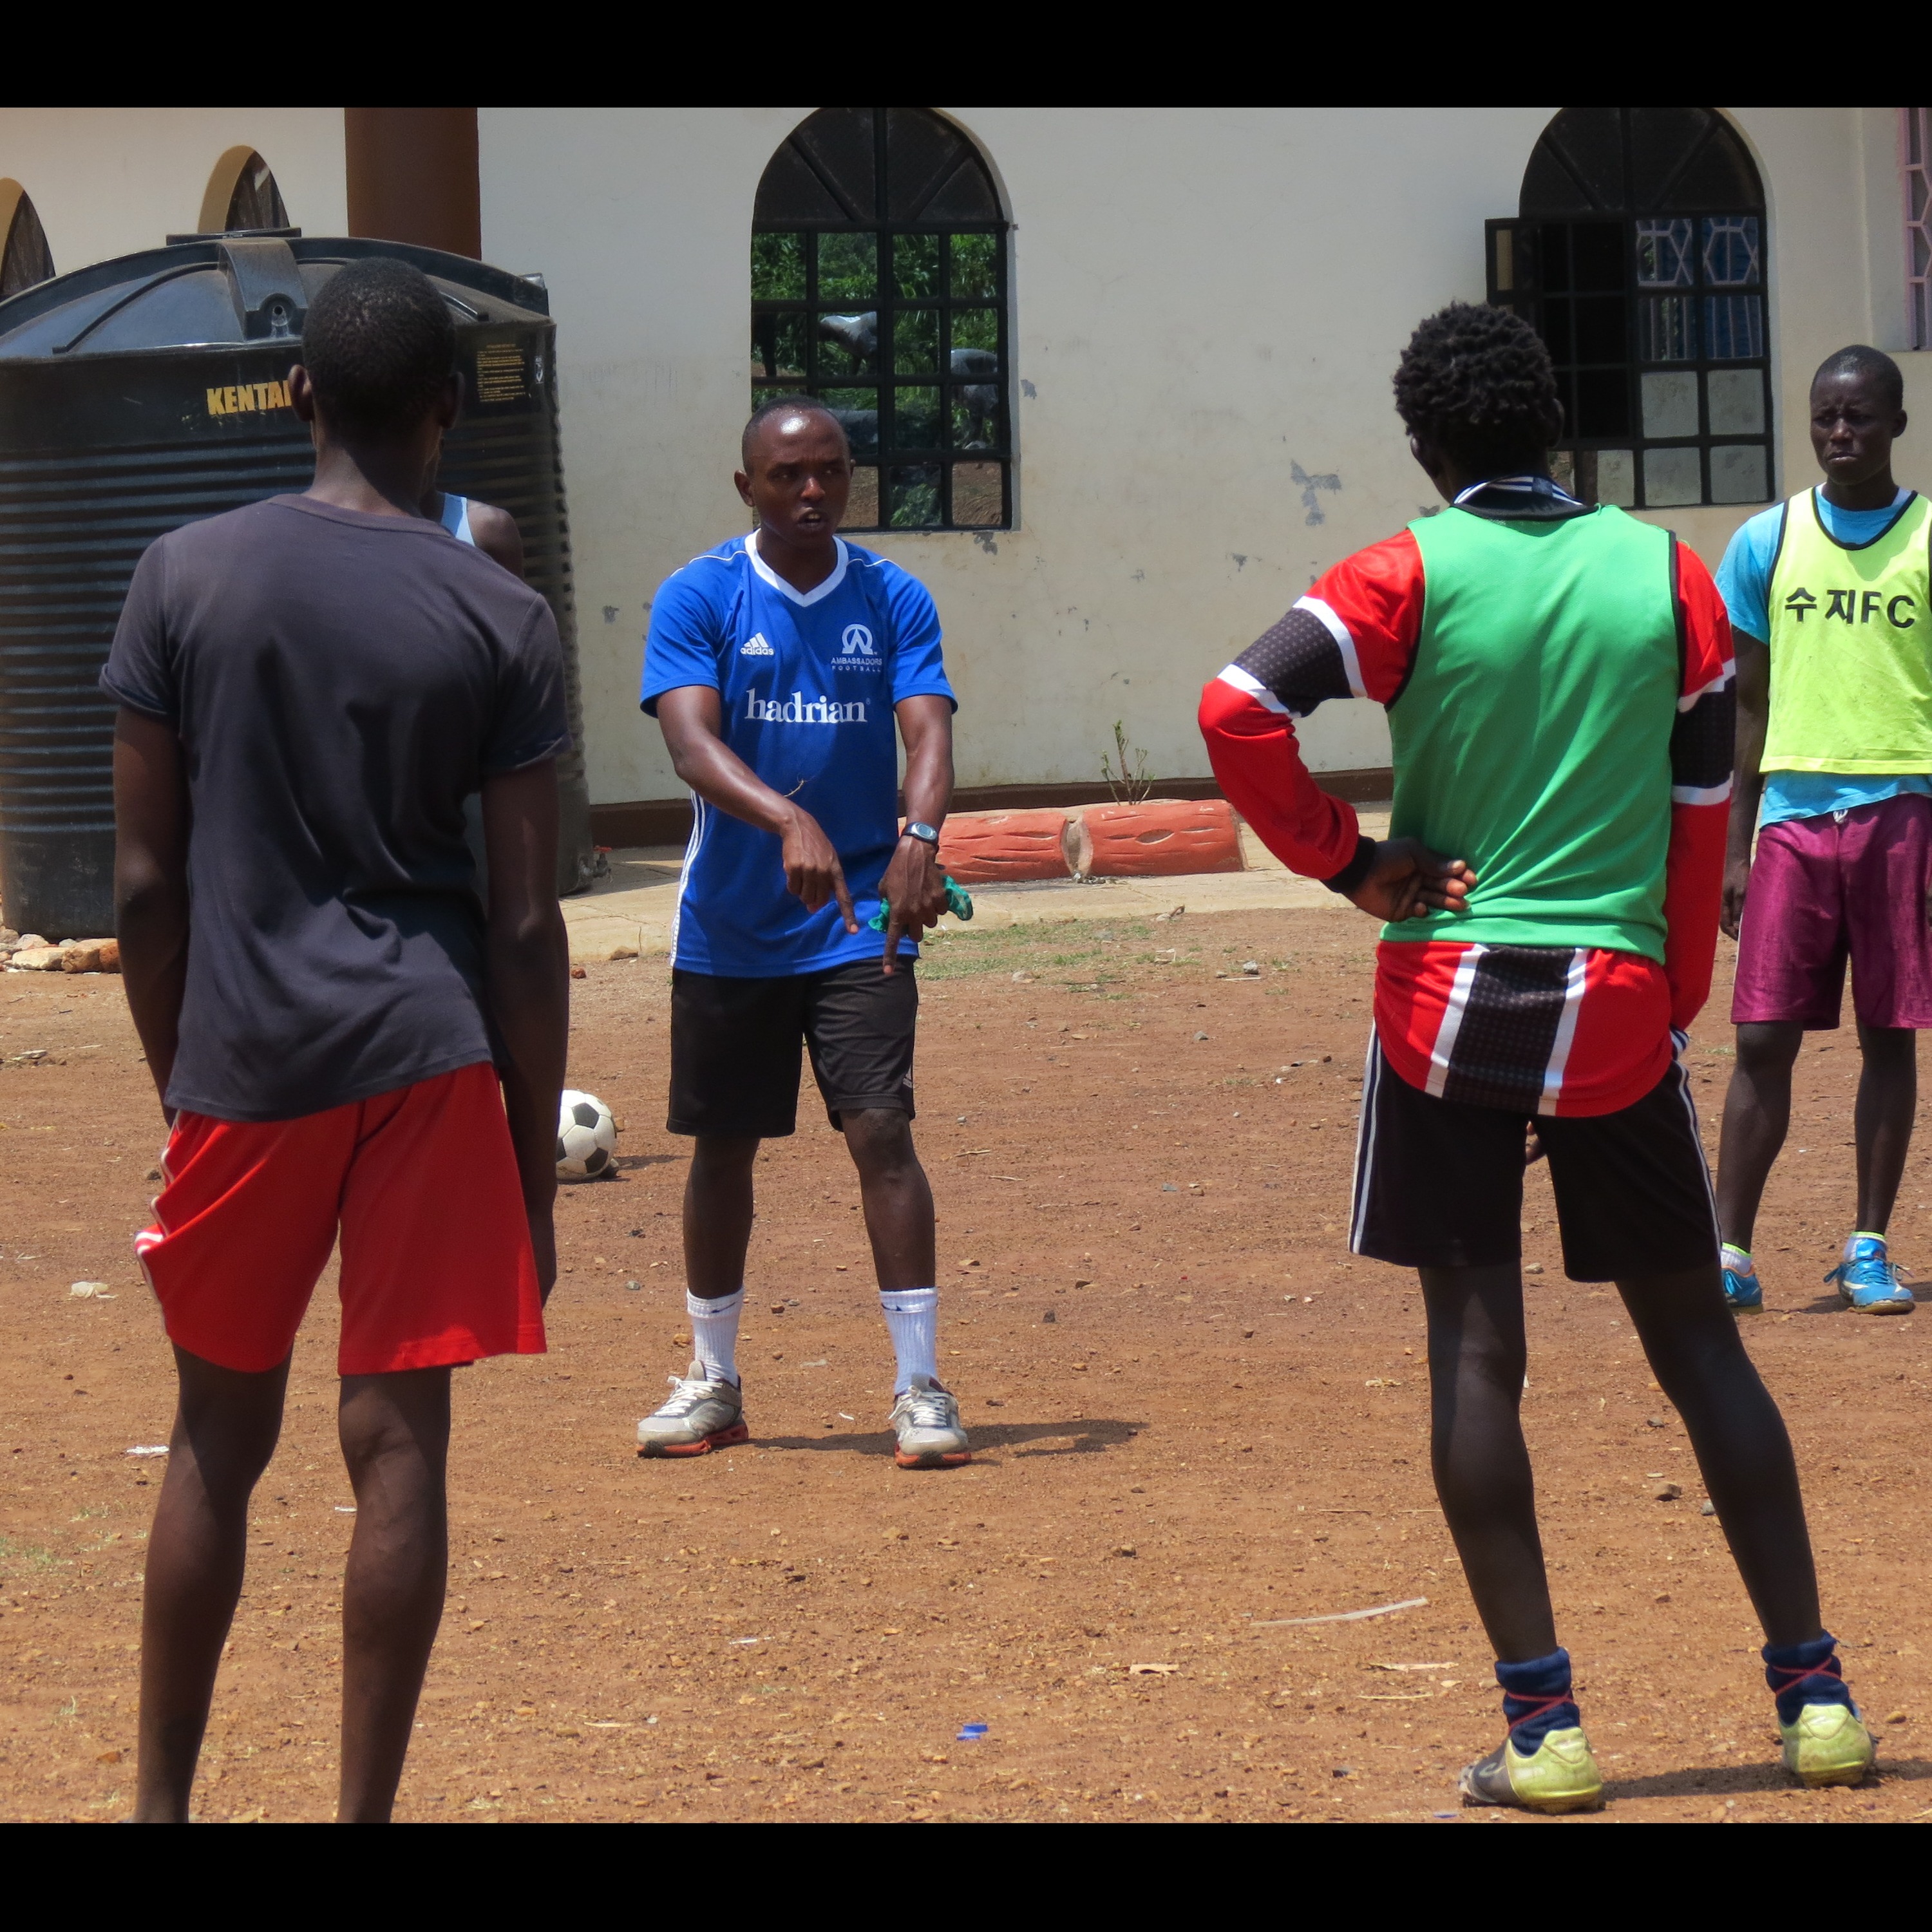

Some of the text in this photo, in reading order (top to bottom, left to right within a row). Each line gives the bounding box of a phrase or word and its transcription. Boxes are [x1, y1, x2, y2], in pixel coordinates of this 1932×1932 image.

[741, 647, 774, 656] adidas
[831, 657, 882, 665] AMBASSADORS
[744, 688, 867, 723] hadrian
